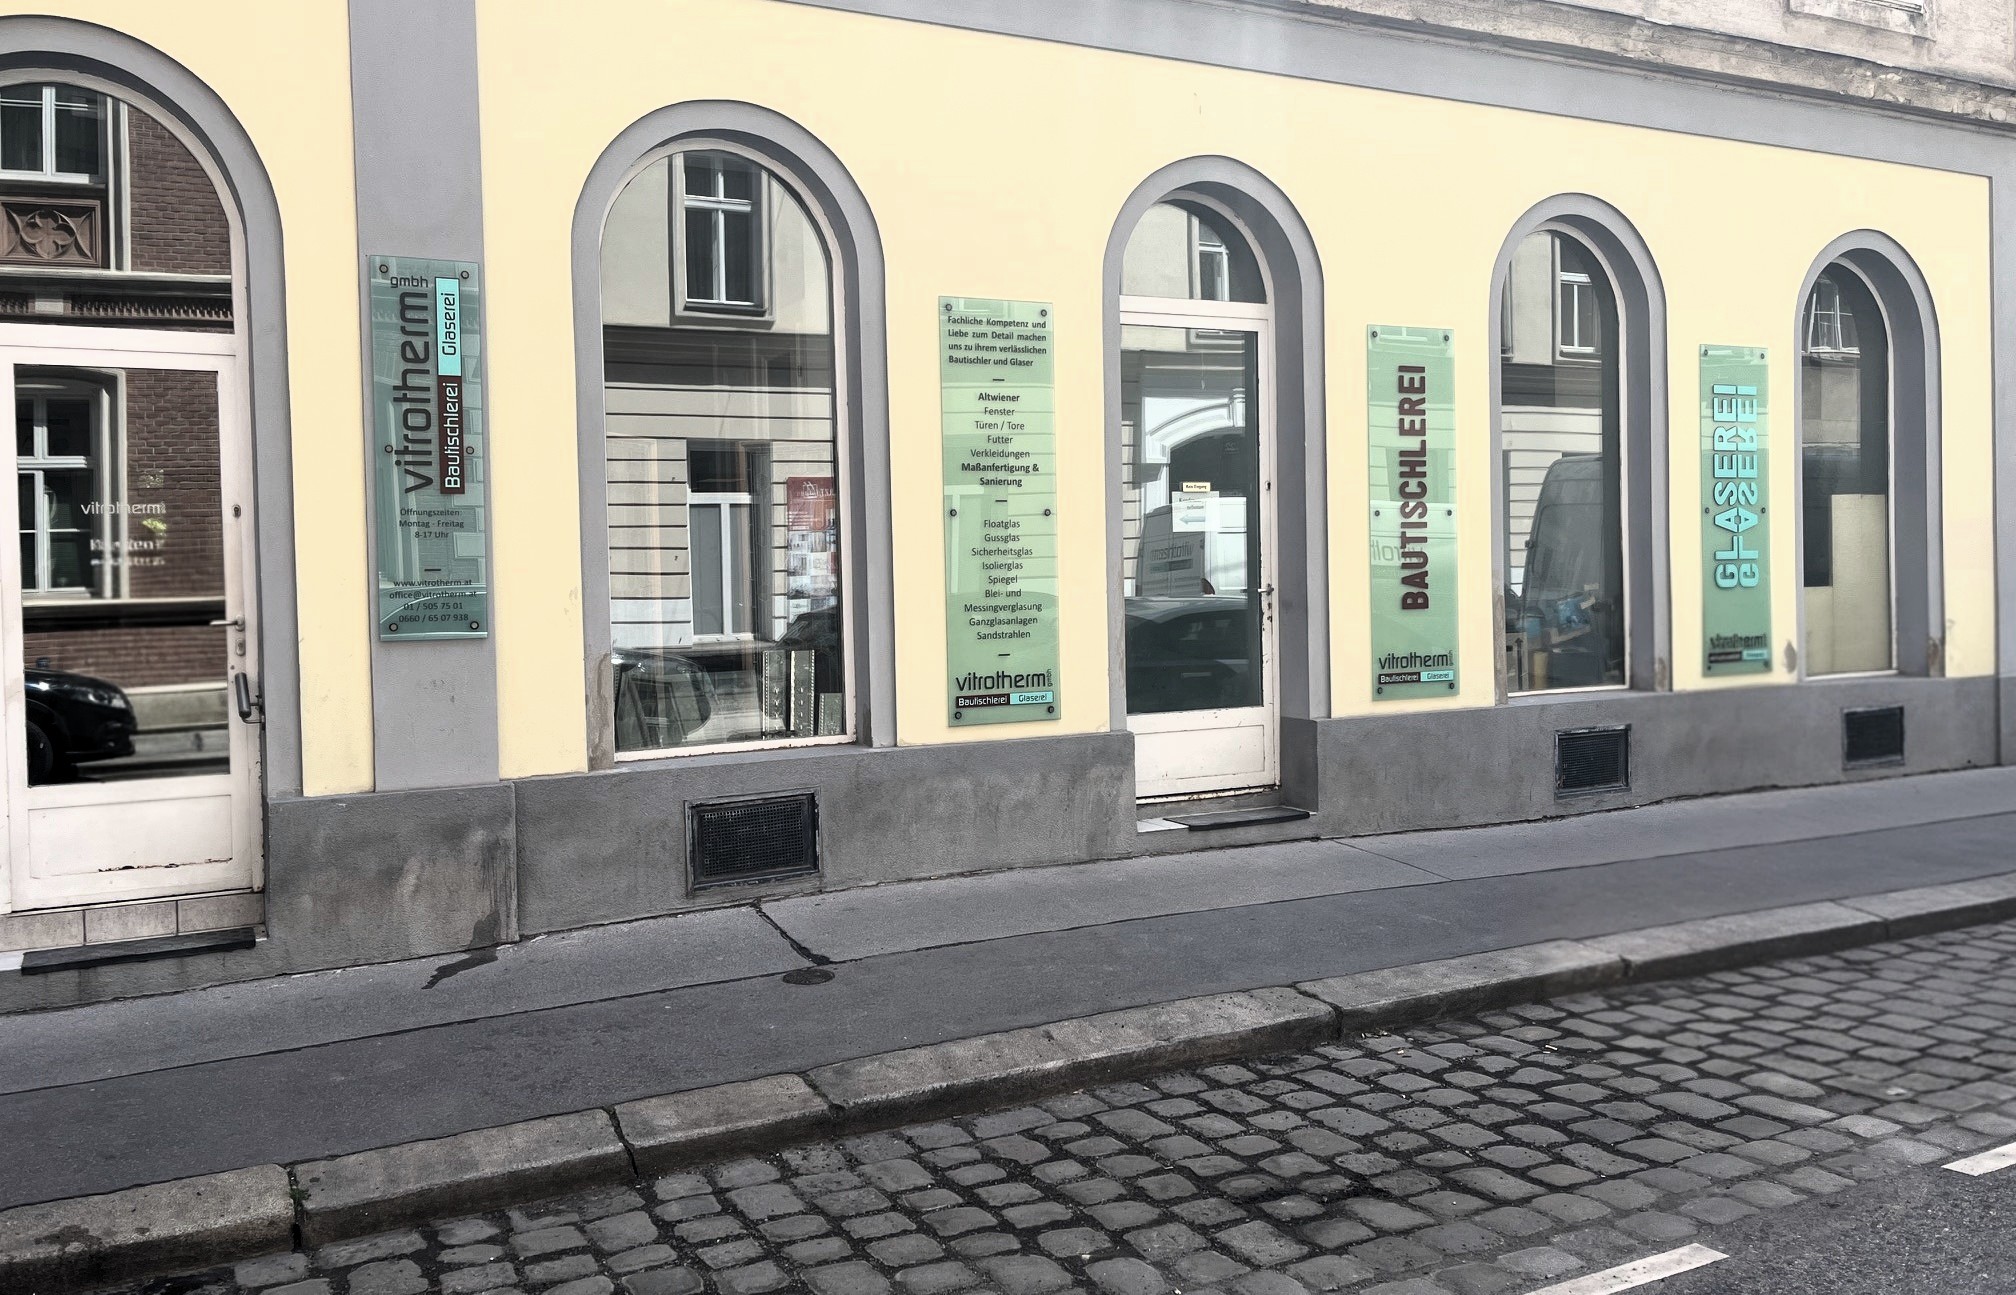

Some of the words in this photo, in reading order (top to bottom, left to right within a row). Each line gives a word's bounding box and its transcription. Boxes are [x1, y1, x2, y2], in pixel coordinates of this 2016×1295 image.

[390, 276, 428, 288] gmbh
[441, 292, 456, 356] Glaserei
[948, 316, 984, 326] Fachliche
[986, 318, 1028, 328] Kompetenz
[1032, 320, 1046, 328] und
[948, 329, 968, 338] Liebe
[992, 332, 1014, 340] Detail
[1017, 333, 1046, 342] machen
[974, 344, 997, 352] ihrem
[999, 345, 1046, 354] verlässlichen
[948, 356, 992, 365] Bautischler
[994, 357, 1008, 366] und
[1010, 358, 1034, 366] Glaser
[392, 292, 434, 494] vitrotherm
[978, 392, 1020, 402] Altwiener
[984, 406, 1015, 416] Fenster
[975, 420, 998, 430] Türen
[1000, 422, 1004, 430] /
[1007, 422, 1025, 430] Tore
[442, 382, 460, 488] Bautischlerei
[987, 434, 1013, 444] Futter
[970, 448, 1030, 460] Verkleidungen
[962, 462, 1030, 474] Maßanfertigung
[1032, 464, 1040, 472] &
[980, 477, 1022, 488] Sanierung
[1398, 365, 1429, 610] BAUTISCHLEREI
[1713, 384, 1738, 588] GLASEREI
[399, 520, 430, 528] Montag
[437, 520, 464, 528] Freitag
[984, 520, 1020, 530] Floatglas
[984, 533, 1020, 544] Gussglas
[972, 548, 1033, 558] Sicherheitsglas
[982, 561, 1024, 572] Isolierglas
[988, 575, 1018, 586] Spiegel
[389, 590, 477, 600] office@vitrotherm.at
[985, 589, 1004, 598] Blei-
[1006, 588, 1022, 598] und
[404, 602, 414, 610] 01
[416, 602, 420, 611] /
[964, 602, 1042, 614] Messingverglasung
[422, 614, 426, 622] /
[969, 616, 1038, 628] Ganzglasanlagen
[976, 630, 1030, 640] Sandstrahlen
[1378, 652, 1448, 670] vitrotherm
[956, 670, 1046, 691] vitrotherm
[1380, 674, 1419, 684] Bautischlerei
[958, 696, 1008, 706] Bautischlerei
[1018, 693, 1048, 702] Glaserei
